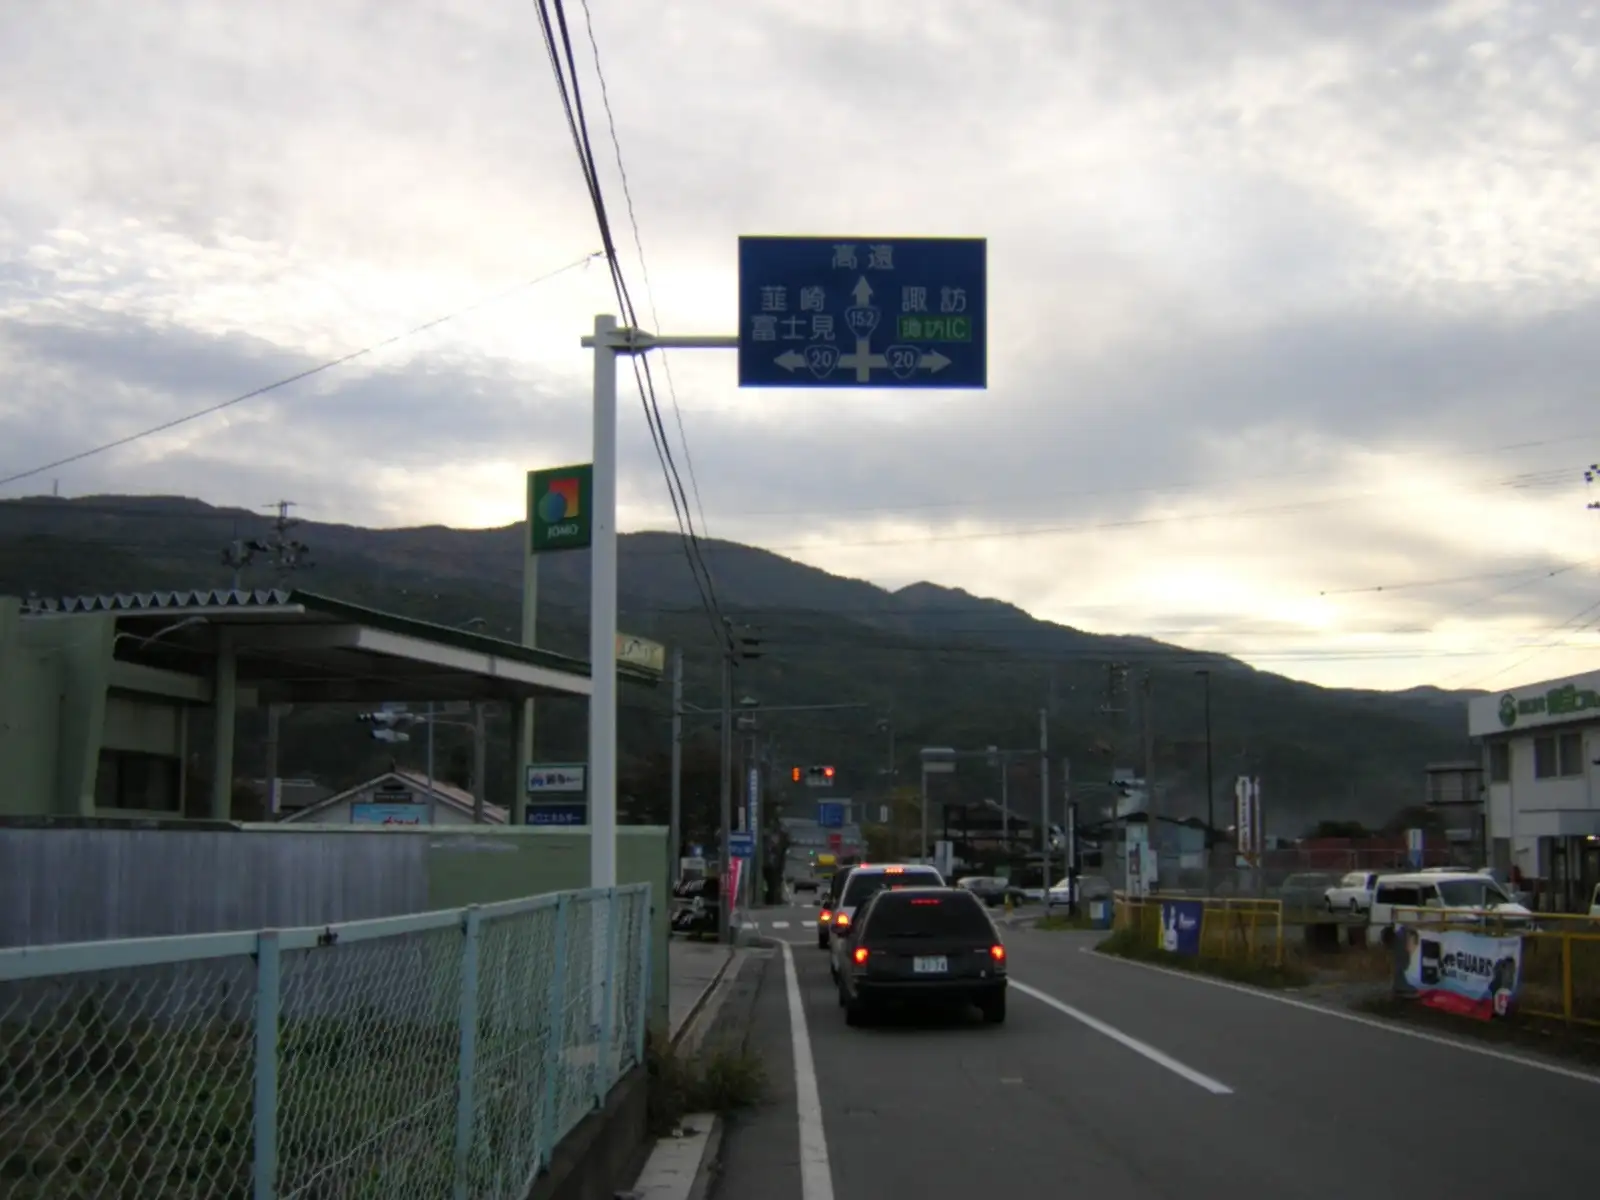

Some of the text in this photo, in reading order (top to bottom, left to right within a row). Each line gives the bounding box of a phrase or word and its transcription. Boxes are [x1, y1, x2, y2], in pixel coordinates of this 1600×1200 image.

[832, 244, 895, 270] 高遠
[761, 286, 825, 312] 韮崎
[901, 286, 967, 313] 諏訪
[751, 315, 836, 342] 富士見
[851, 311, 874, 327] 152
[812, 351, 832, 367] 20
[893, 351, 914, 367] 20
[547, 524, 579, 539] JOMO
